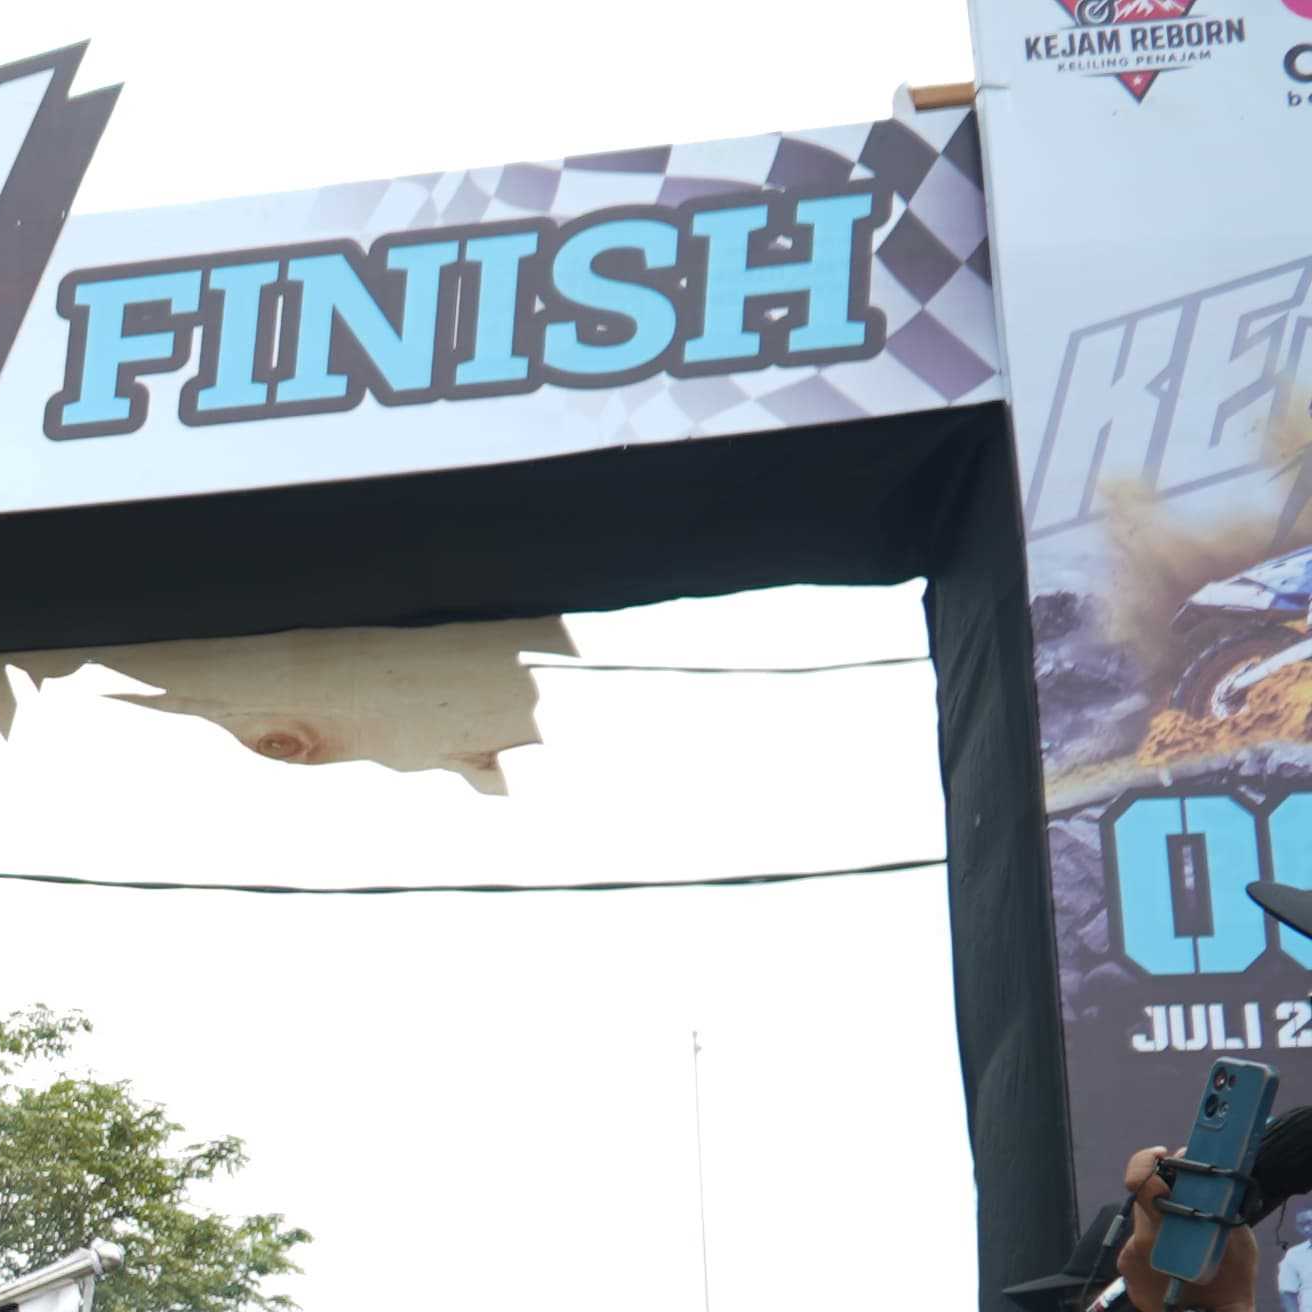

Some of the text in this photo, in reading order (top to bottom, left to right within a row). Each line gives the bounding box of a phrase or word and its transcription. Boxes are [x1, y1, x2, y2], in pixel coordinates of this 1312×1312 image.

[1025, 17, 1245, 62] KEJAM REBORN
[1058, 50, 1212, 73] KELILING PENAJAM
[60, 192, 874, 427] FINISH
[1131, 1003, 1261, 1052] JULI
